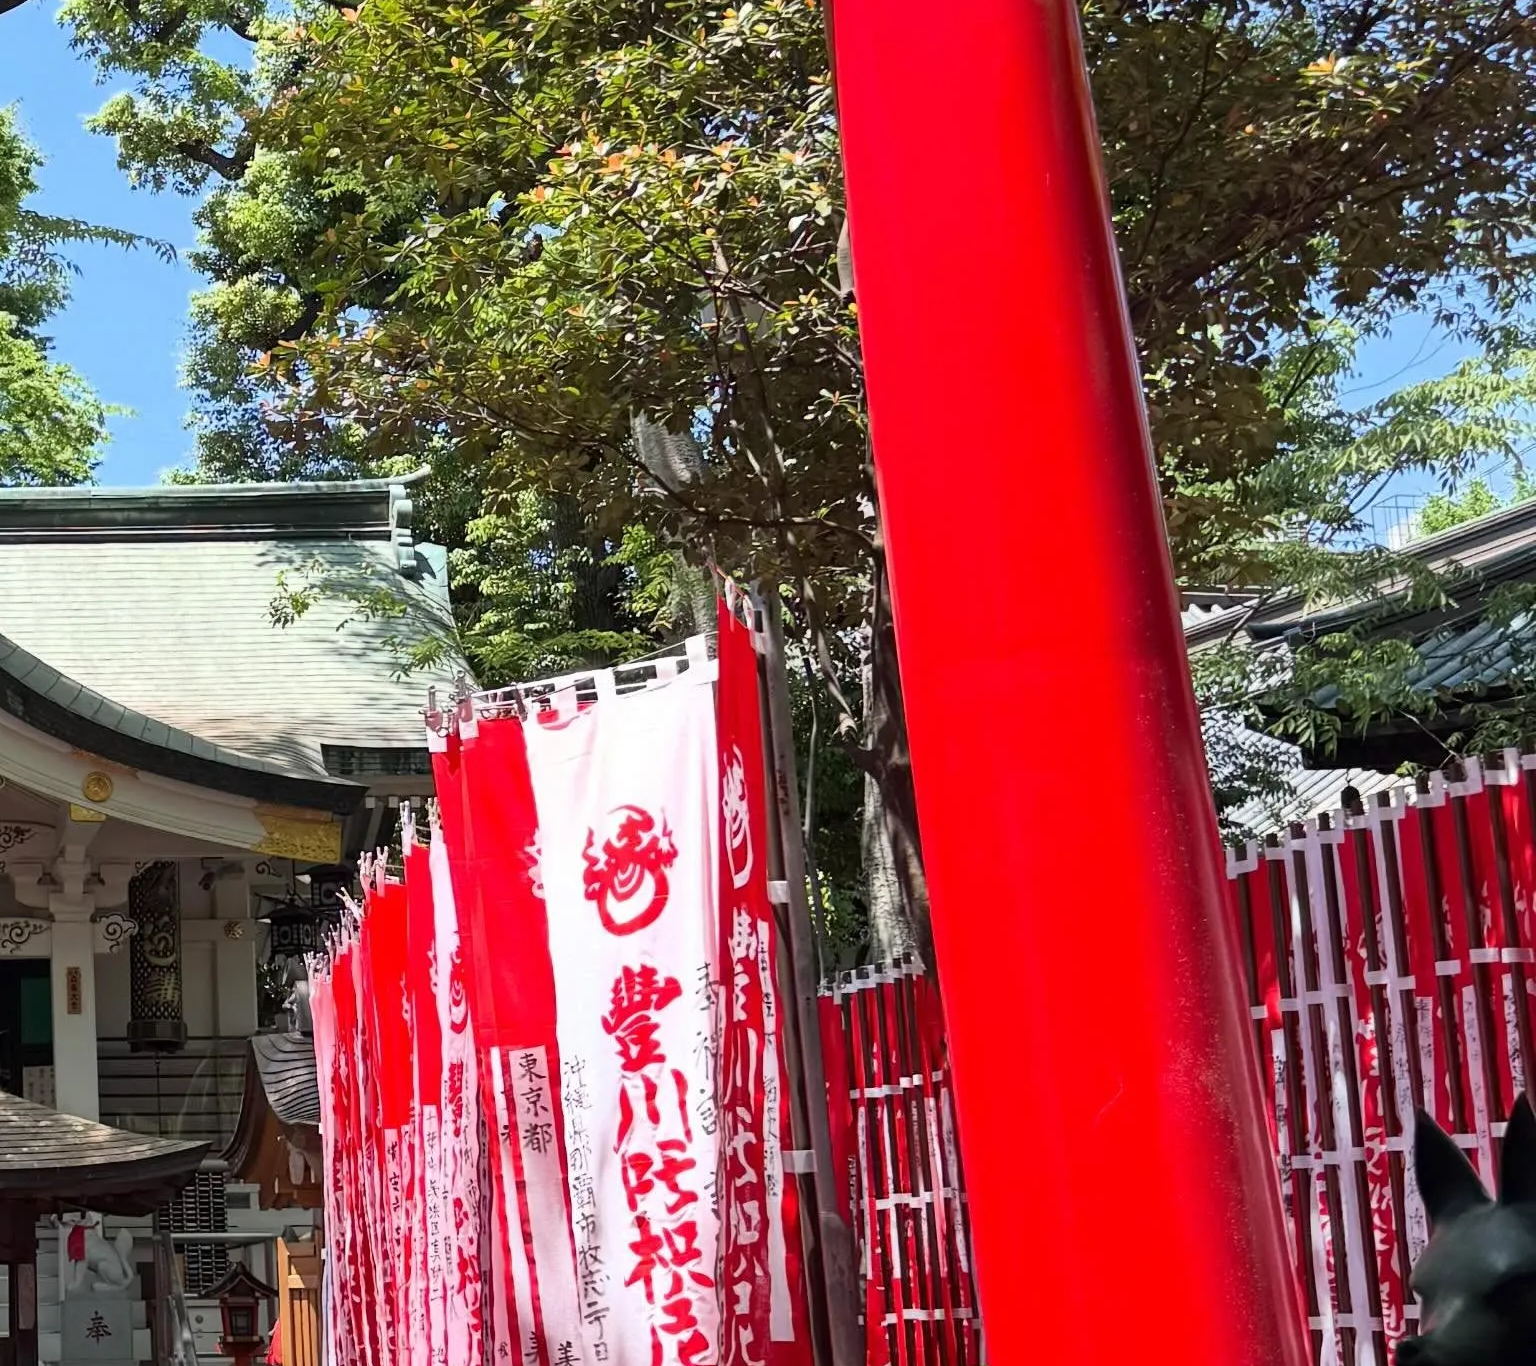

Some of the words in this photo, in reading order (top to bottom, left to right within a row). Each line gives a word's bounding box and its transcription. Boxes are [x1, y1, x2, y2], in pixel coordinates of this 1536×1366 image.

[518, 1052, 552, 1154] 東京都
[85, 1310, 112, 1346] 奉
